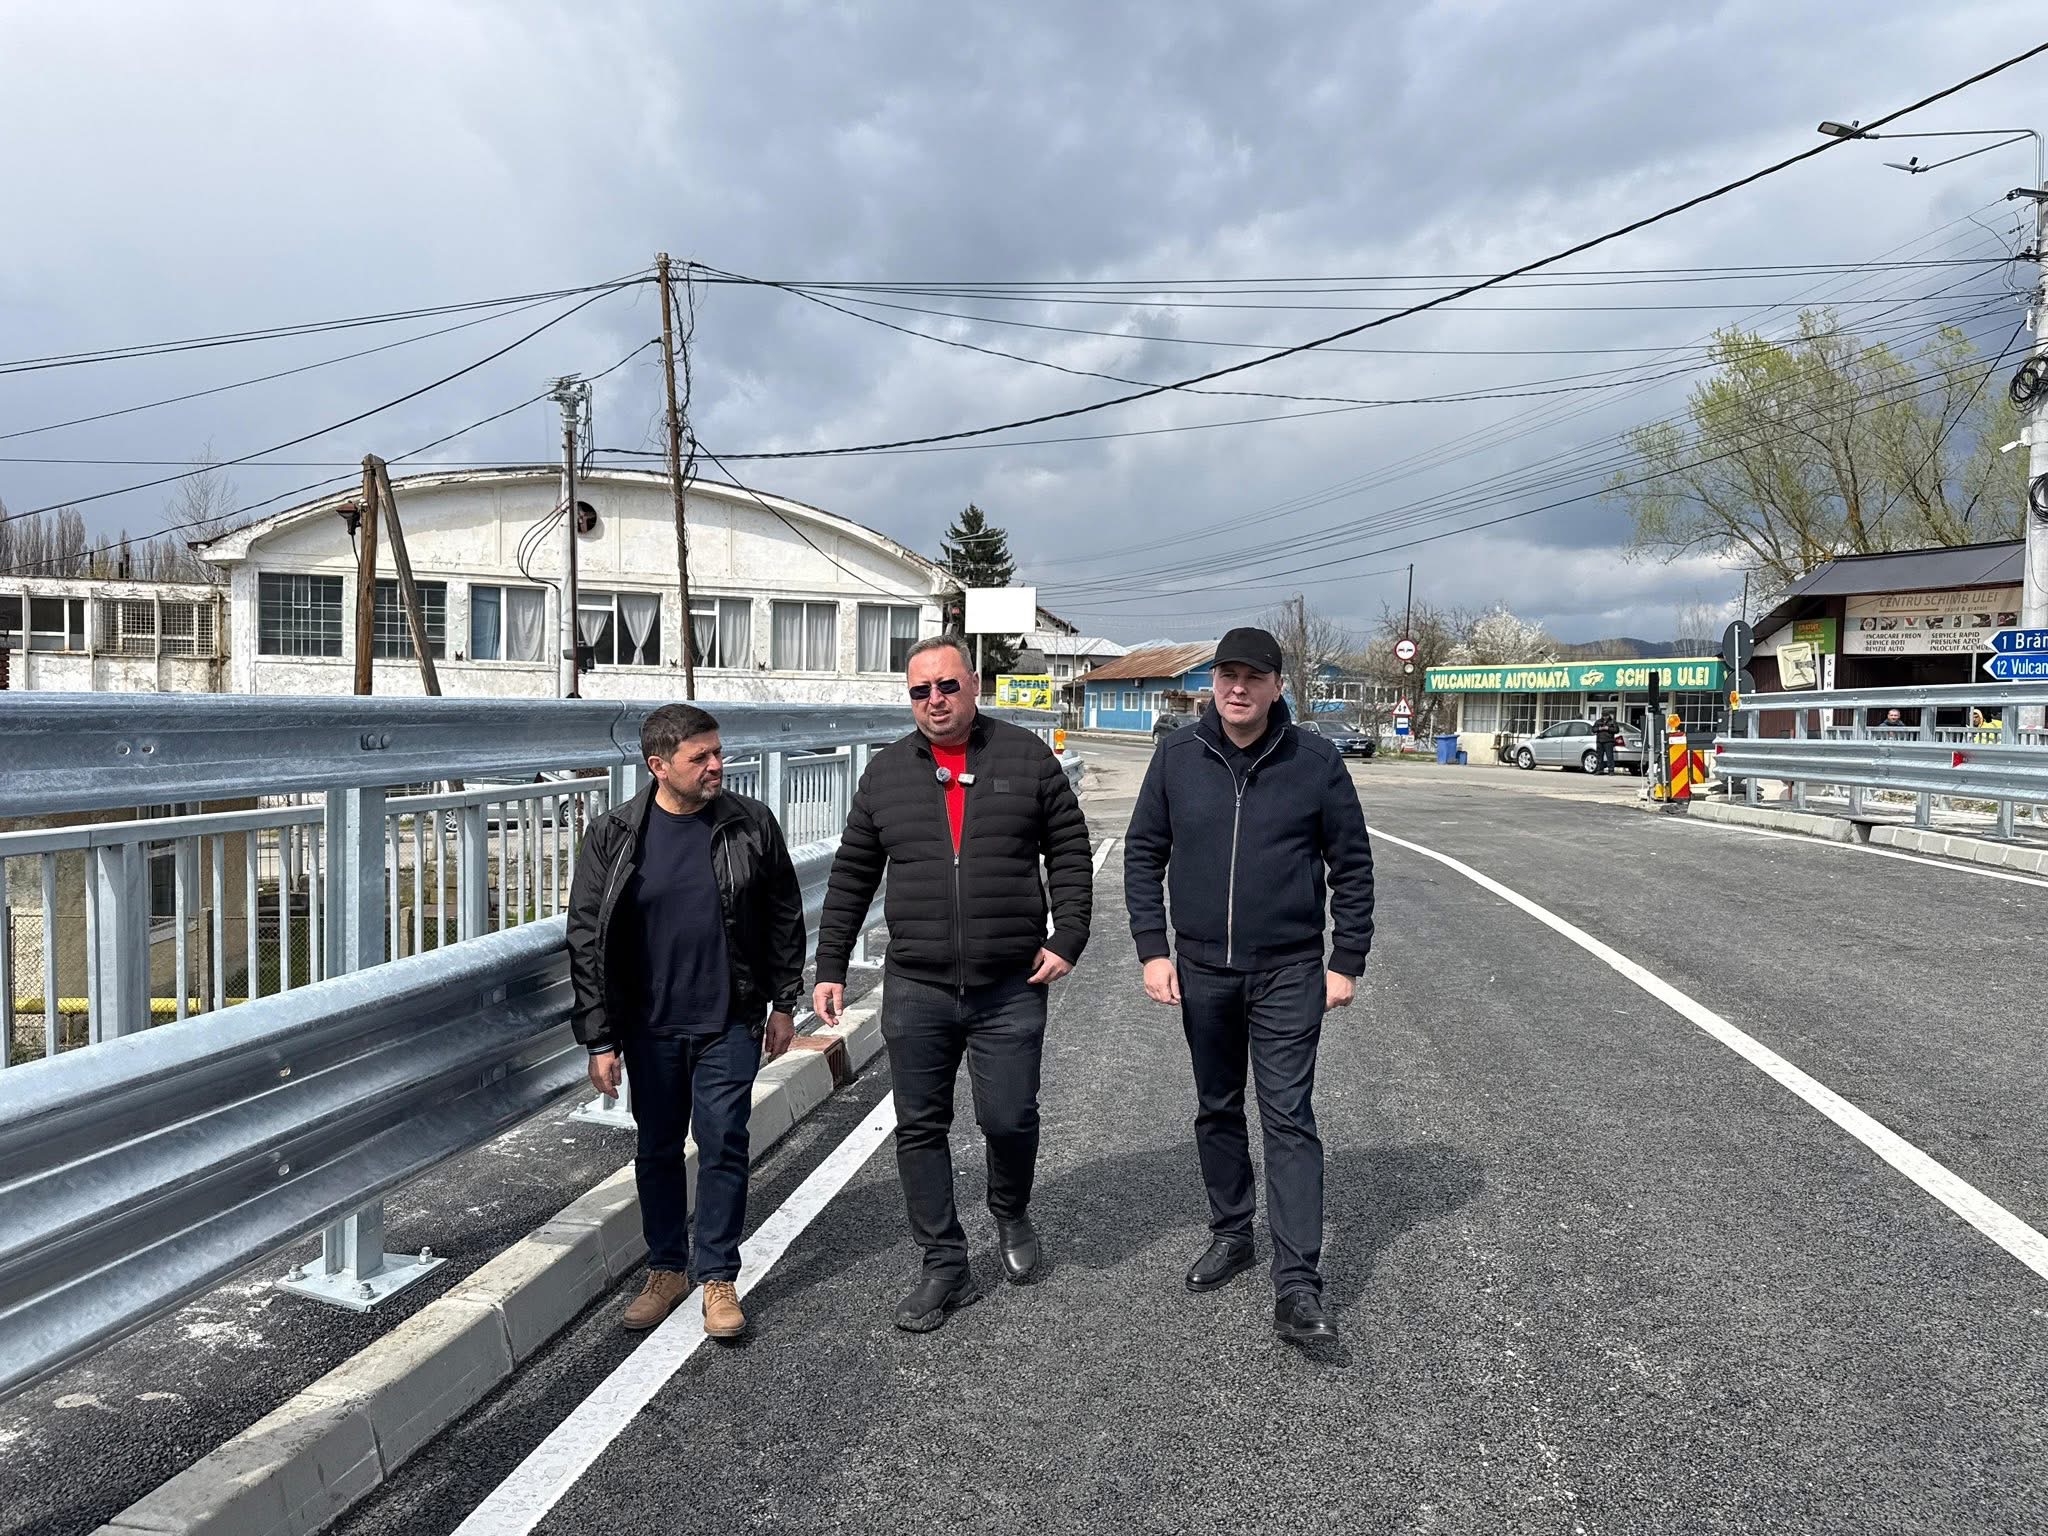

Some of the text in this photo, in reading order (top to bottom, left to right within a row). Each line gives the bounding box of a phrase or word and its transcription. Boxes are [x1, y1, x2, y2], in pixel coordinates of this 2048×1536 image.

[1879, 591, 1999, 607] CENTRU SCHIMB ULEI
[2002, 635, 2008, 650] 1
[1996, 660, 2008, 675] 12
[1009, 679, 1049, 689] OCEAN
[1430, 673, 1502, 689] VULCANIZARE
[1505, 667, 1570, 689] AUTOMATĂ
[1677, 666, 1709, 686] ULEI
